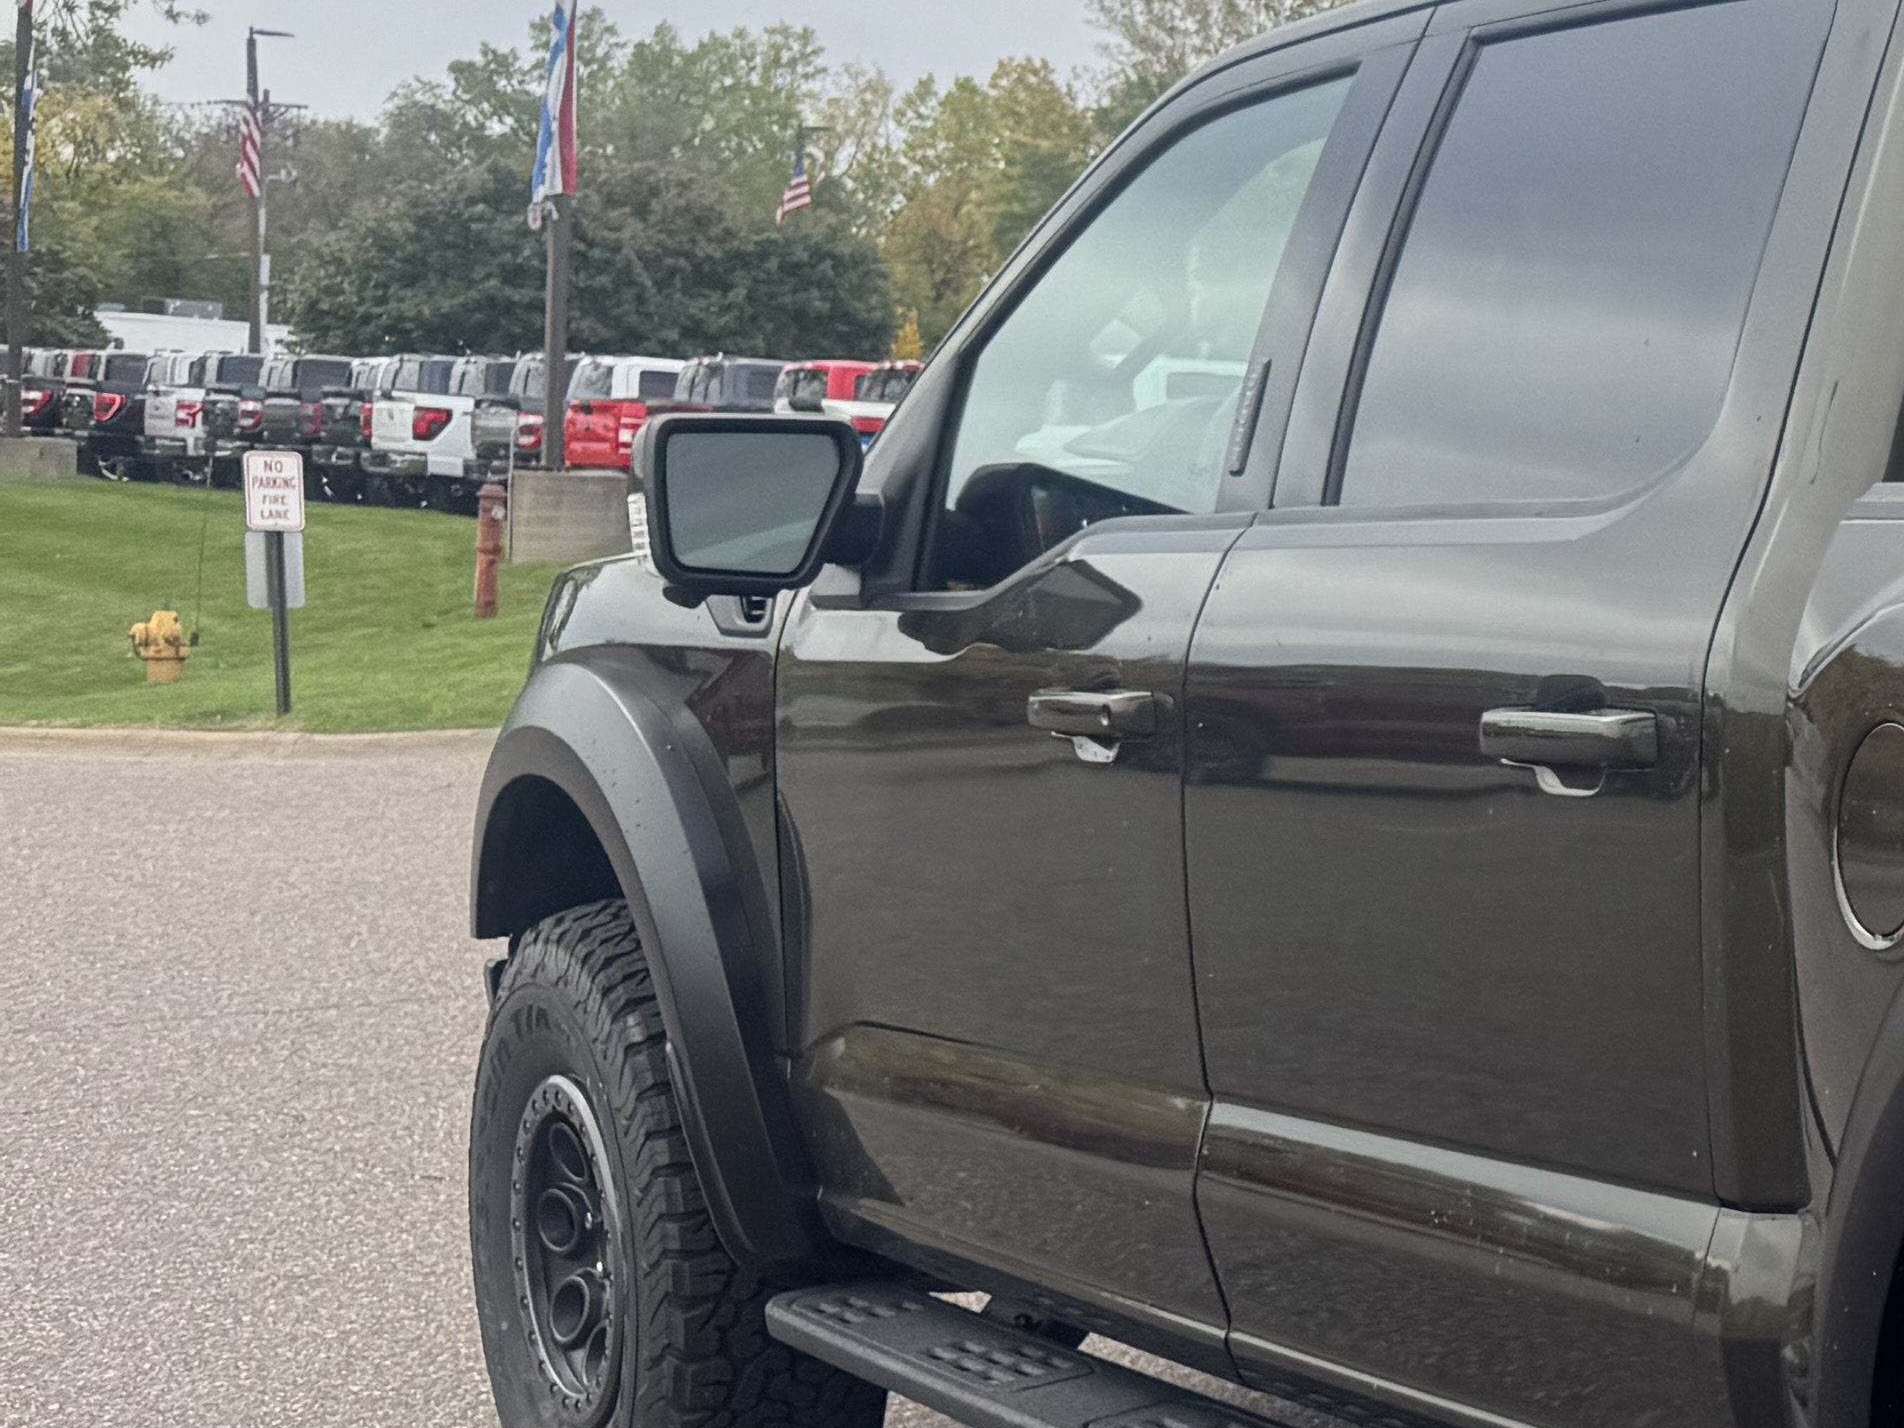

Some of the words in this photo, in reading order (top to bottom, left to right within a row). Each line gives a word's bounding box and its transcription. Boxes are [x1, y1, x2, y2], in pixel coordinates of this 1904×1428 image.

[263, 460, 284, 473] NO
[252, 476, 297, 489] PARKING
[262, 494, 289, 506] FIRE
[260, 509, 290, 521] LANE
